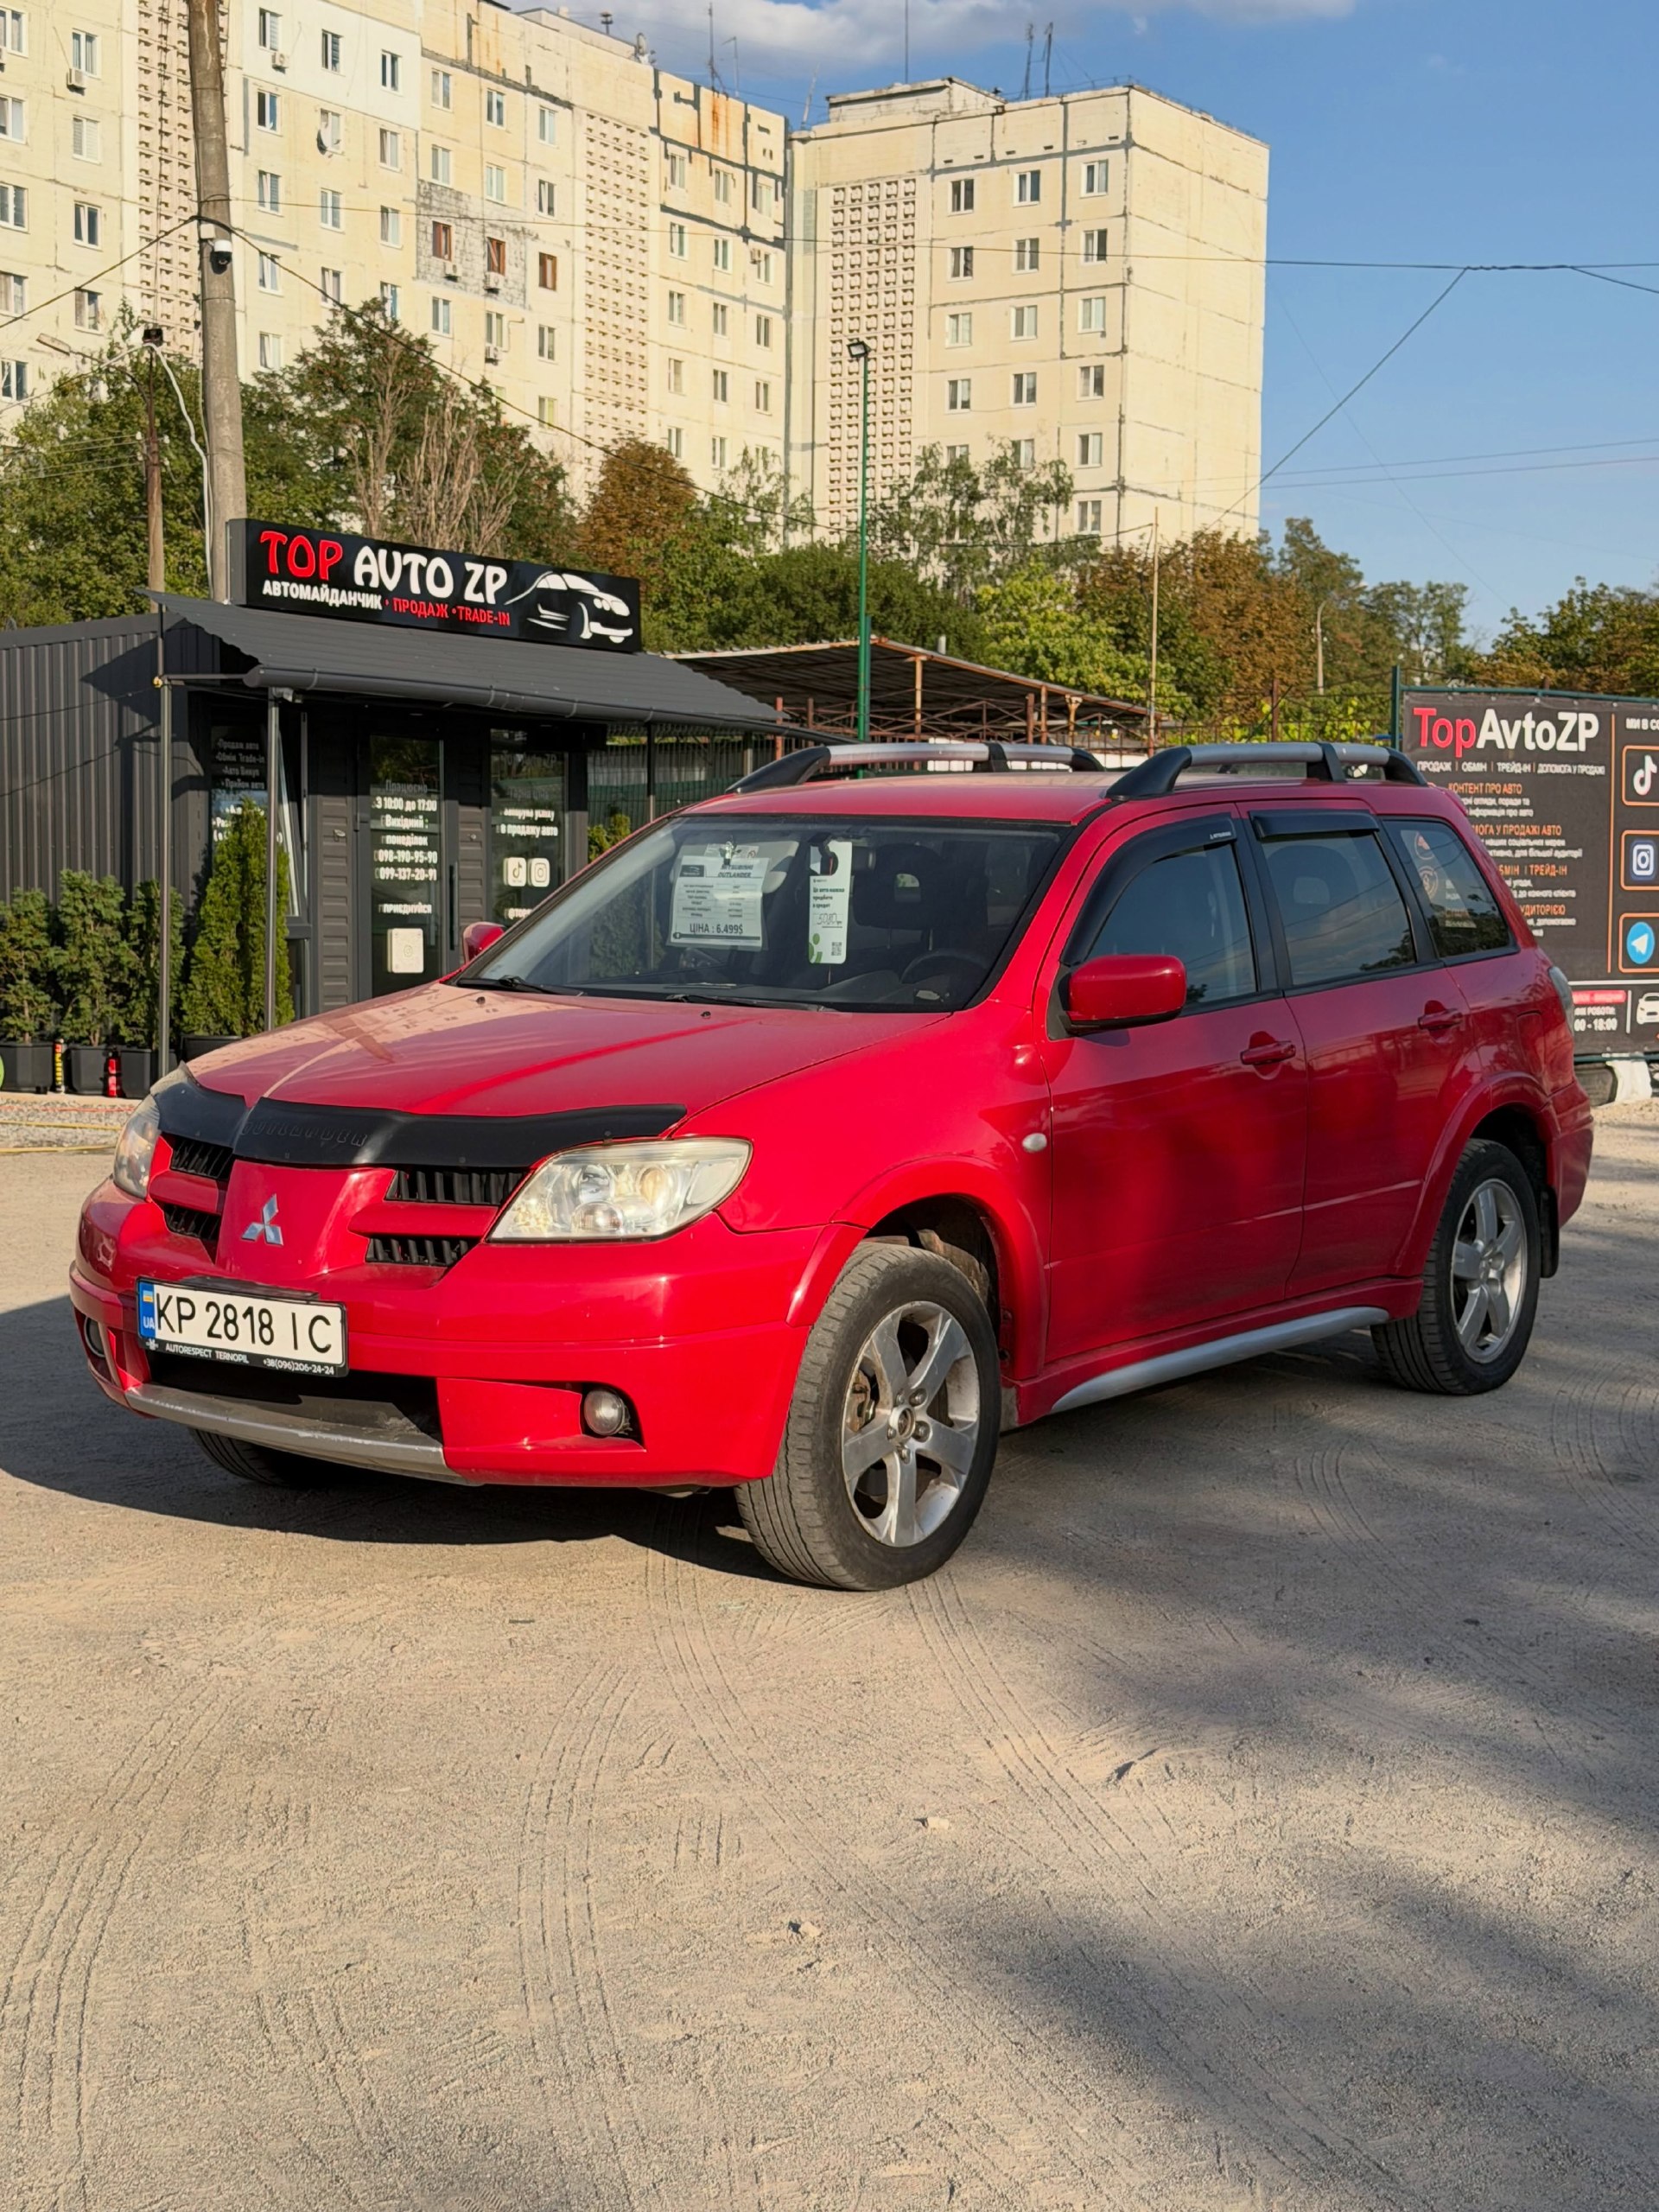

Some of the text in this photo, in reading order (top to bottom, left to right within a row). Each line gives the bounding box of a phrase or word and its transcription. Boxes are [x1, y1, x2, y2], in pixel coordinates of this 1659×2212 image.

[260, 530, 508, 605] TOP AVTO ZP
[262, 579, 511, 626] АВТОМАЙДАНЧИК ПРОДАЖ TRADE-IN
[1413, 707, 1599, 758] TopAvtoZP
[1416, 760, 1452, 773] ПРОДАЖ
[1461, 761, 1487, 772] ОБМІН
[1448, 783, 1522, 795] КОНТЕНТ ПРО АВТО
[384, 797, 404, 810] 10:00
[404, 800, 416, 811] до
[417, 798, 437, 811] 17:00
[1503, 824, 1541, 836] ПРОДАЖІ
[1541, 824, 1561, 836] АВТО
[1529, 863, 1568, 876] ТРЕЙД-ІН
[690, 923, 709, 933] ЦІНА
[716, 924, 743, 934] 6.499$
[143, 1316, 155, 1330] UA
[156, 1294, 332, 1354] KP 2818 IC
[165, 1343, 334, 1376] AUTORESPECT TERNOPIL +38(096)206-24-24
